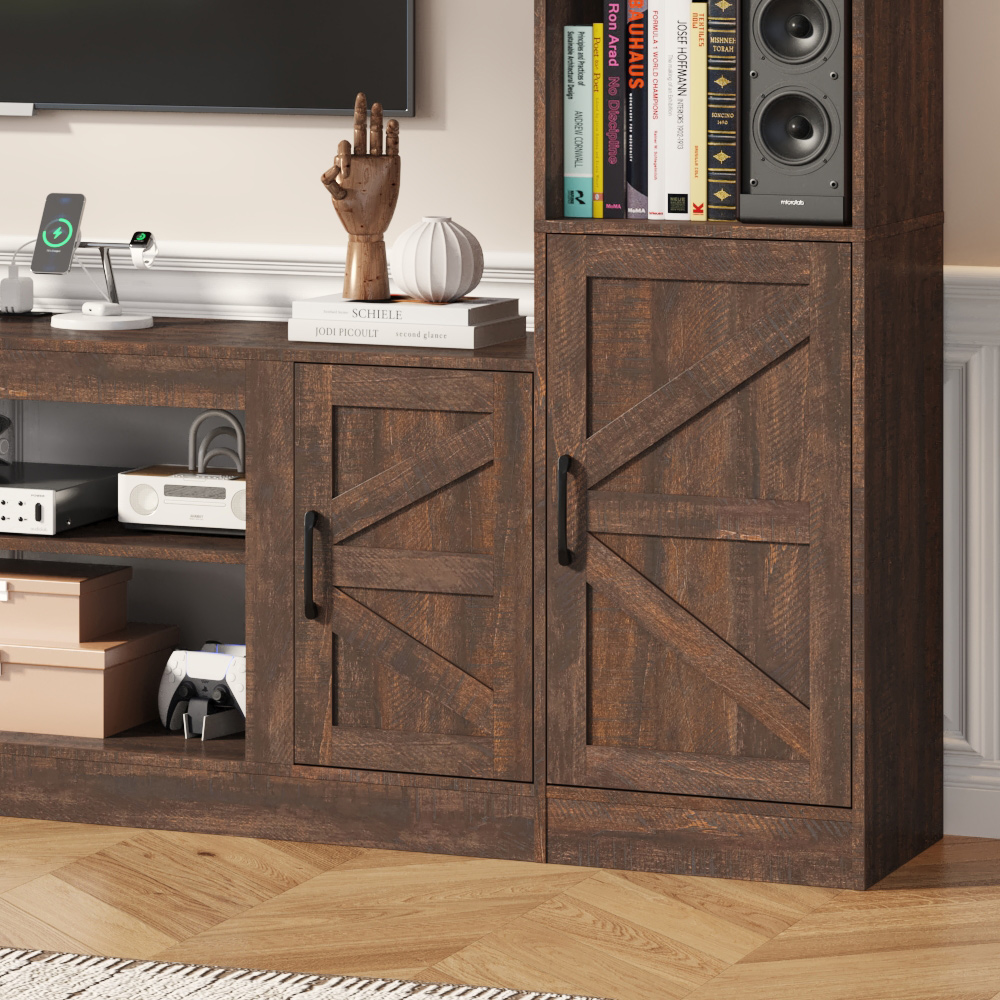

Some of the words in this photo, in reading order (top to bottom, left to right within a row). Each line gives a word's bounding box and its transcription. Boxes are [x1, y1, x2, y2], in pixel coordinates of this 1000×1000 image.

[608, 3, 619, 31] Ron
[566, 30, 575, 55] Sustainable
[577, 31, 586, 52] Principles
[677, 20, 687, 44] JOSEF
[593, 37, 601, 57] Poet
[608, 34, 619, 67] Arad
[712, 45, 734, 53] TORAH
[566, 55, 575, 83] Architectural
[578, 60, 586, 81] Practices
[677, 47, 687, 97] HOFFMANN
[566, 84, 575, 100] Design
[593, 72, 601, 92] Poet
[608, 76, 619, 95] No
[574, 110, 583, 135] ANDREW
[676, 98, 684, 124] INTERIORS
[606, 100, 619, 165] Discipline
[574, 137, 583, 168] CORNWALL
[351, 308, 403, 320] SCHIELE
[315, 326, 336, 337] JODI
[339, 327, 379, 338] PICOULT
[395, 330, 421, 339] second
[423, 331, 447, 340] glance
